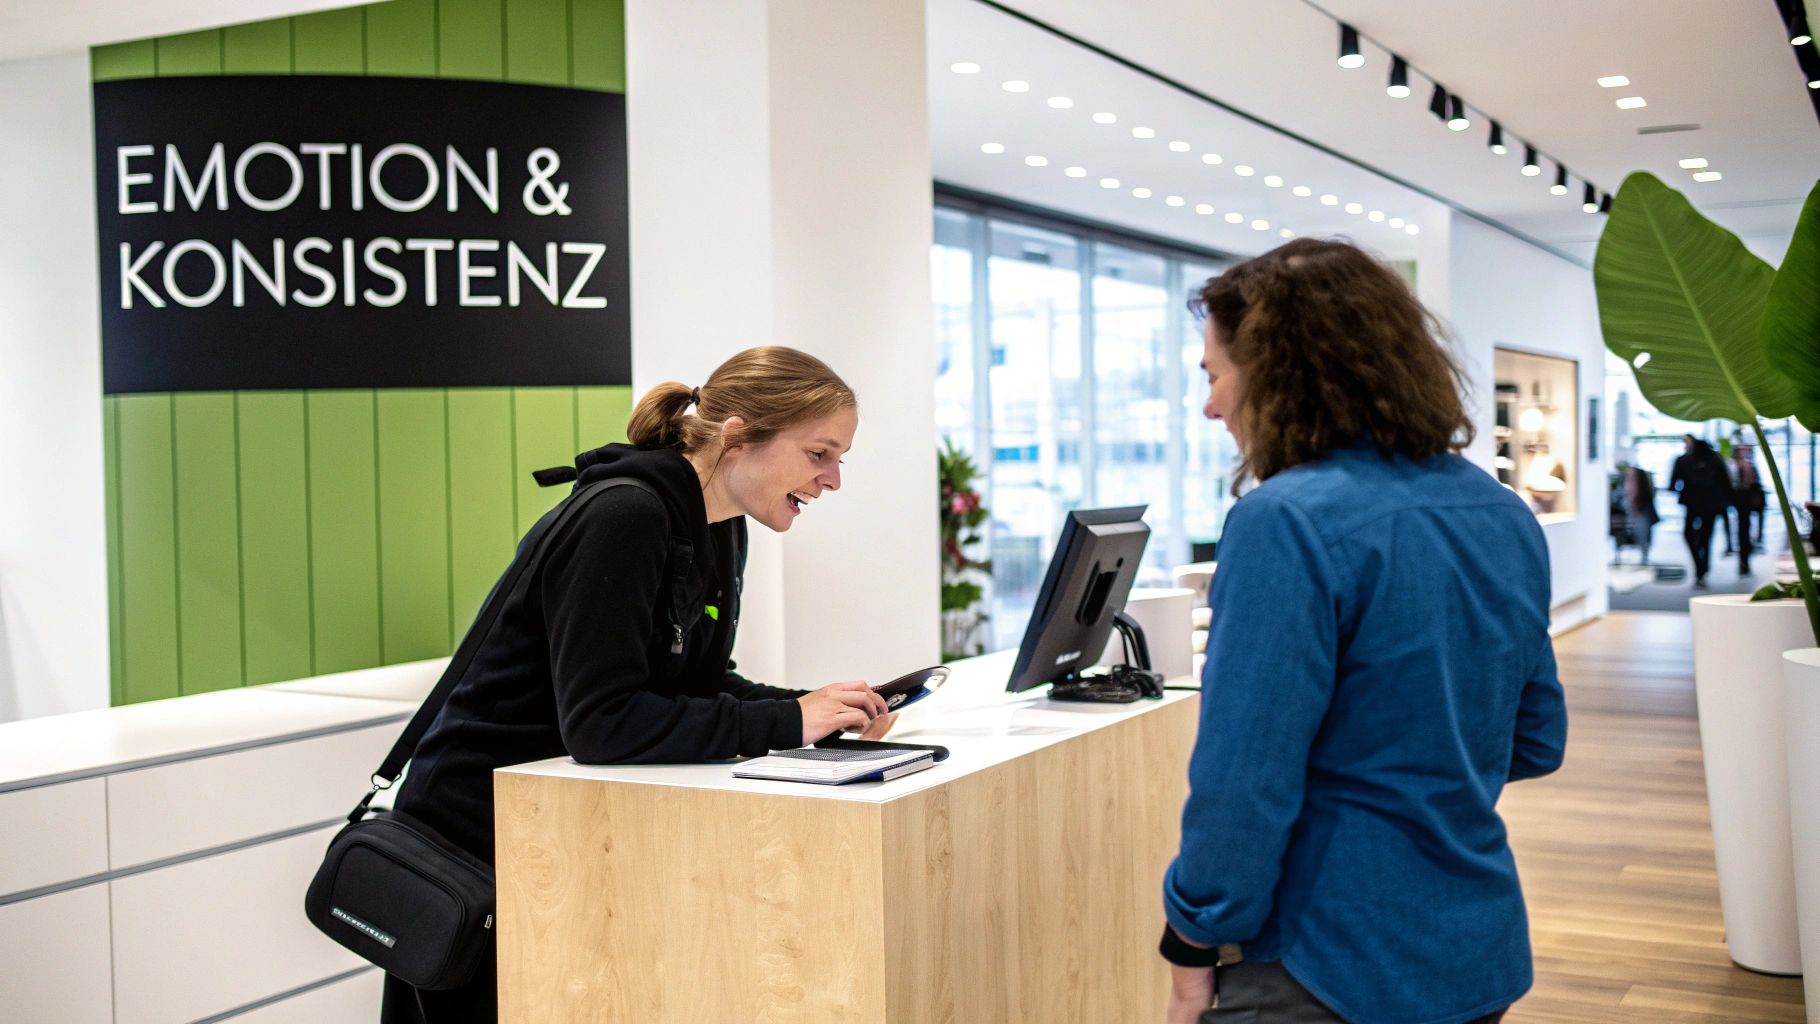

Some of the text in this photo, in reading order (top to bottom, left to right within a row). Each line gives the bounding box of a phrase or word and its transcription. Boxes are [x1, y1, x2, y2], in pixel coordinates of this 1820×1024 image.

[117, 142, 572, 216] EMOTION &
[119, 237, 608, 310] KONSISTENZ
